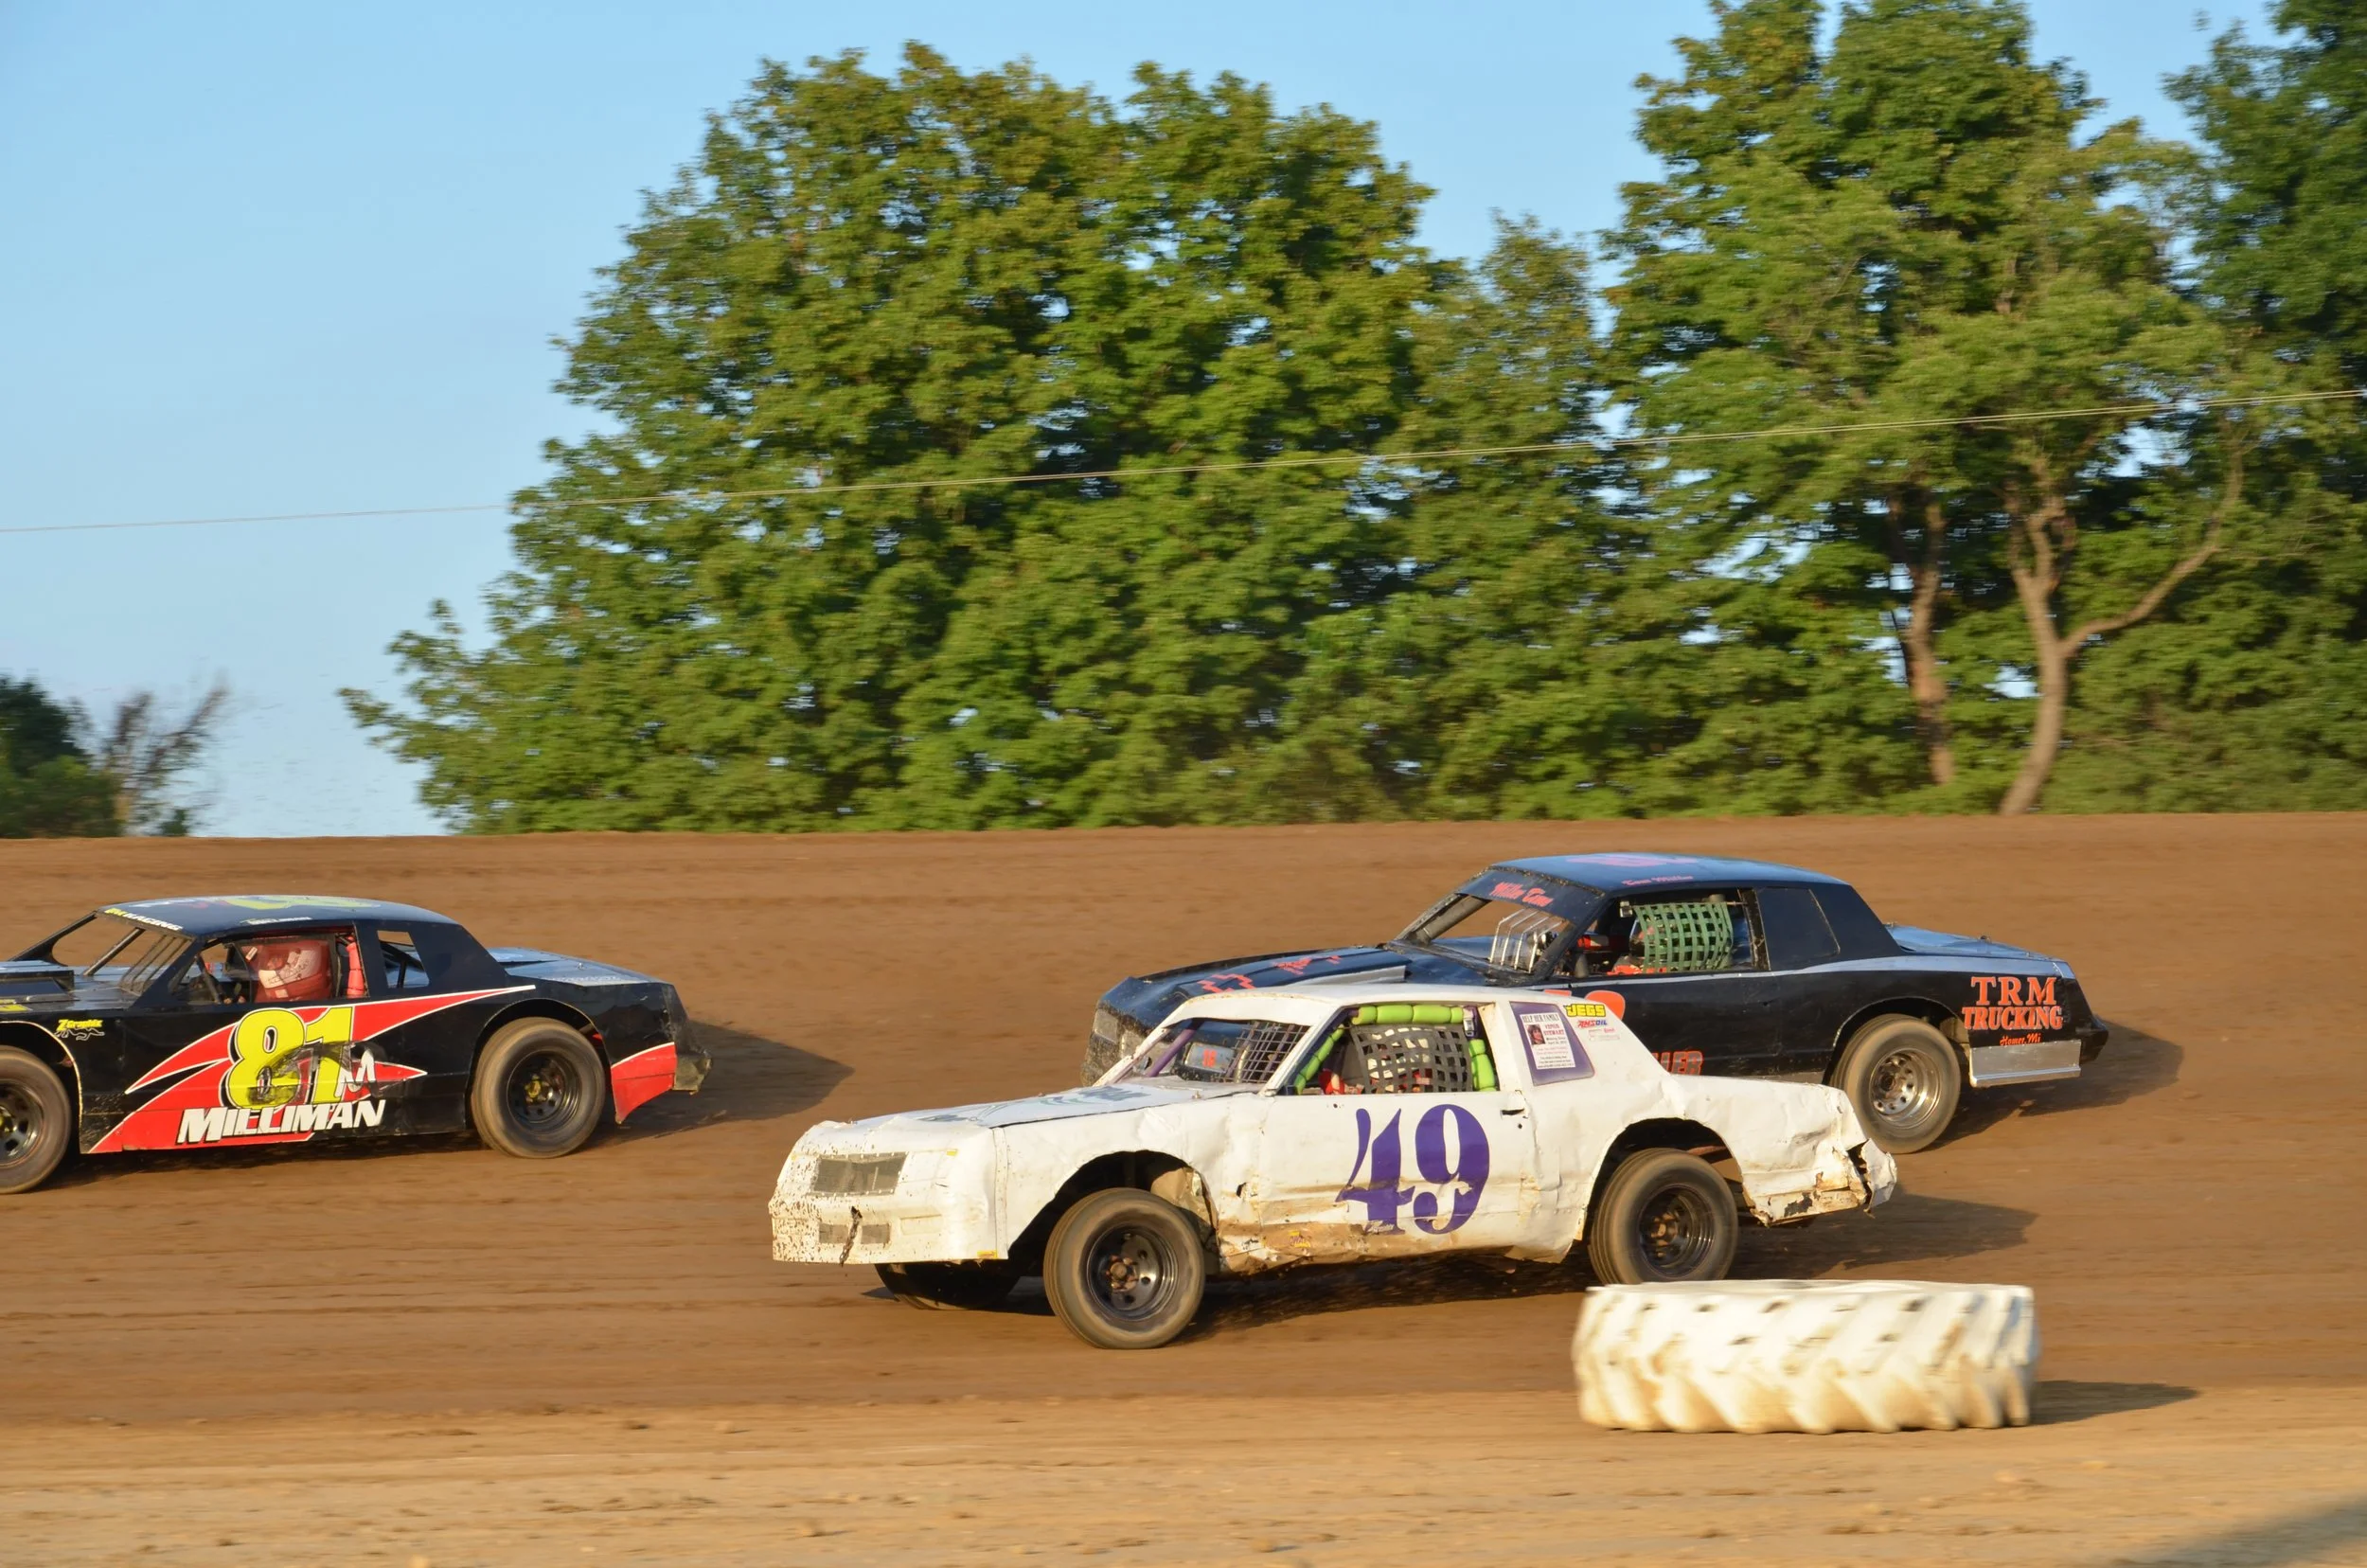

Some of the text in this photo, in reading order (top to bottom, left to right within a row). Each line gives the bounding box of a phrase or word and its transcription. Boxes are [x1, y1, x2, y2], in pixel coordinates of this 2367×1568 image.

[1970, 976, 2057, 1006] TRM
[1564, 1004, 1606, 1017] JEGS
[1962, 1006, 2063, 1030] TRUCKING
[223, 1007, 354, 1110] 81
[177, 1099, 386, 1144] MILLIMAN
[1335, 1104, 1490, 1235] 49
